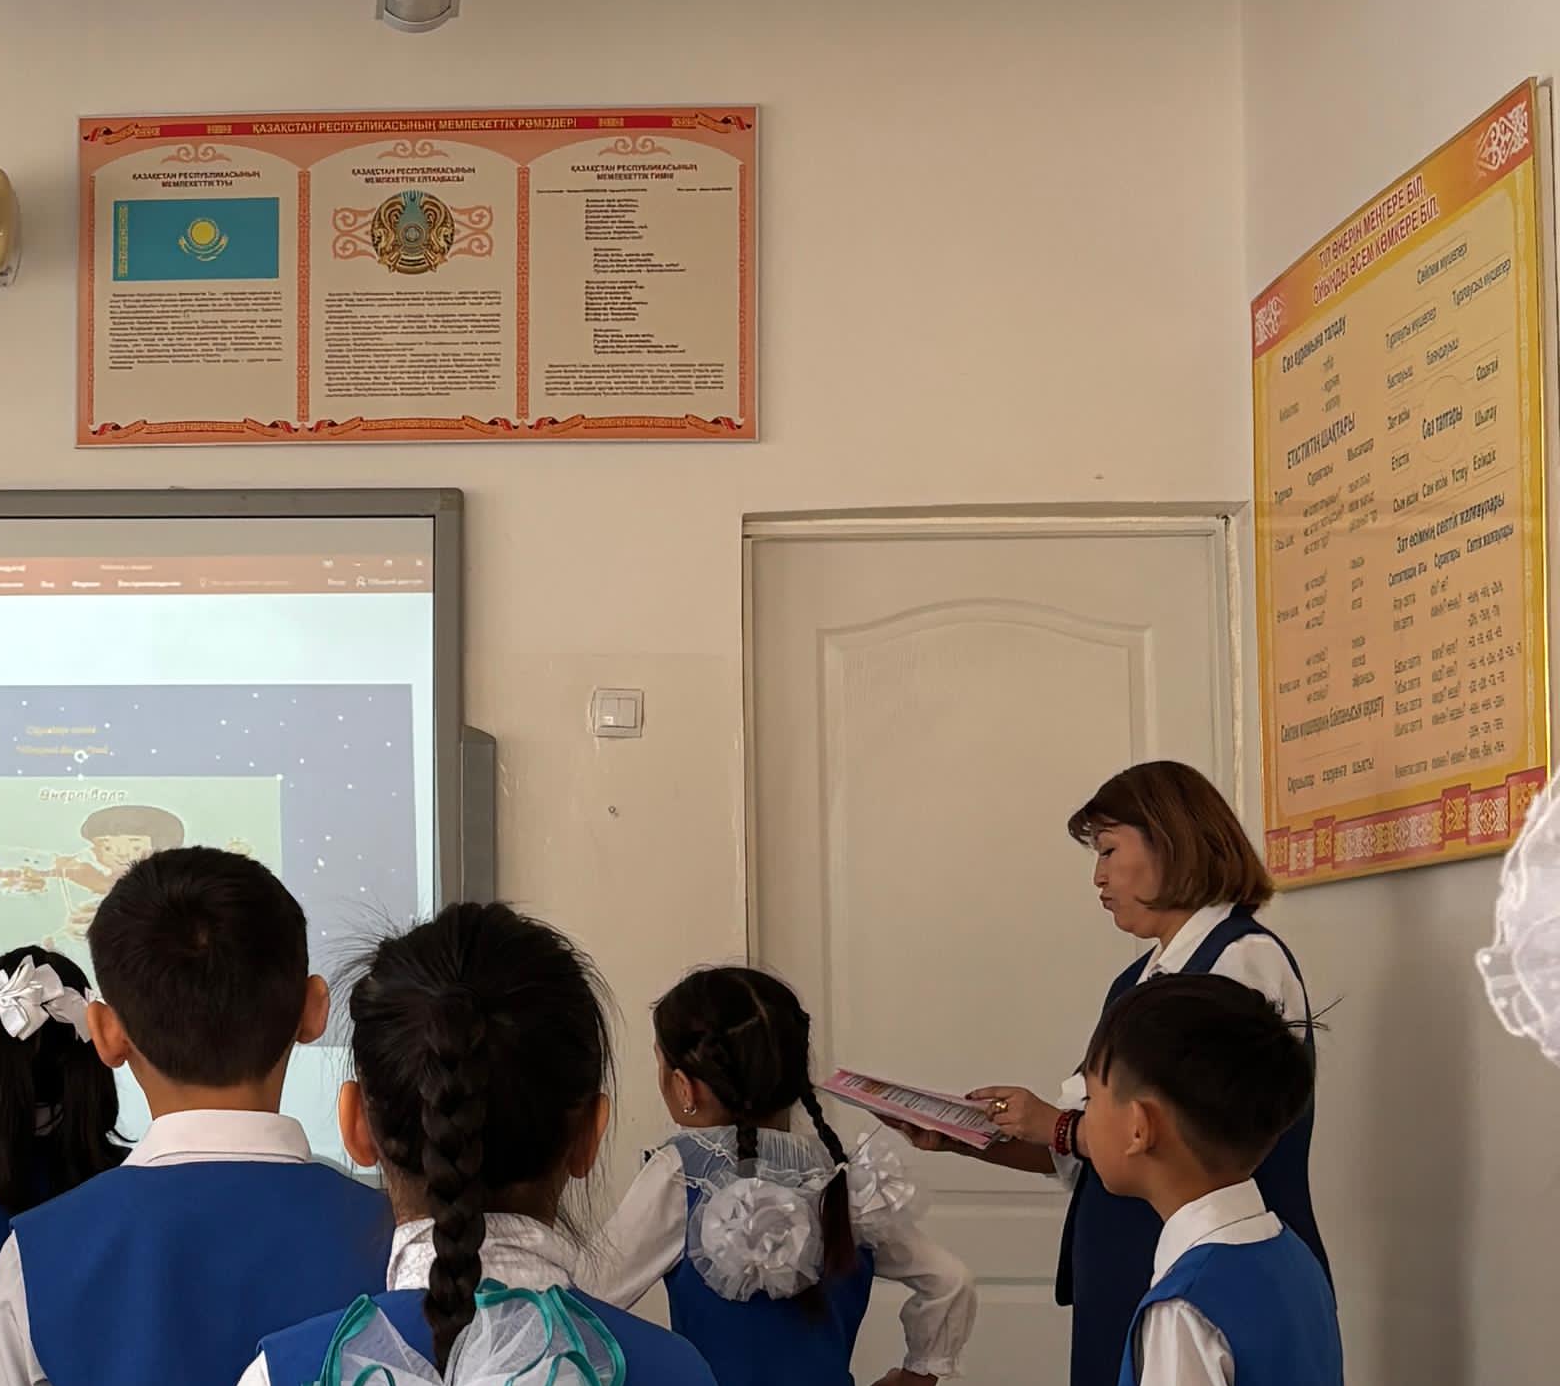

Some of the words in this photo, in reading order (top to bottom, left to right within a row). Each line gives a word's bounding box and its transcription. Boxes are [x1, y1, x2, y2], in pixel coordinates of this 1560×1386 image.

[252, 123, 317, 134] ҚАЗАҚСТАН
[319, 121, 437, 133] РЕСПУБЛИКАСЫНЫҢ
[439, 119, 515, 130] МЕМЛЕКЕТТІК
